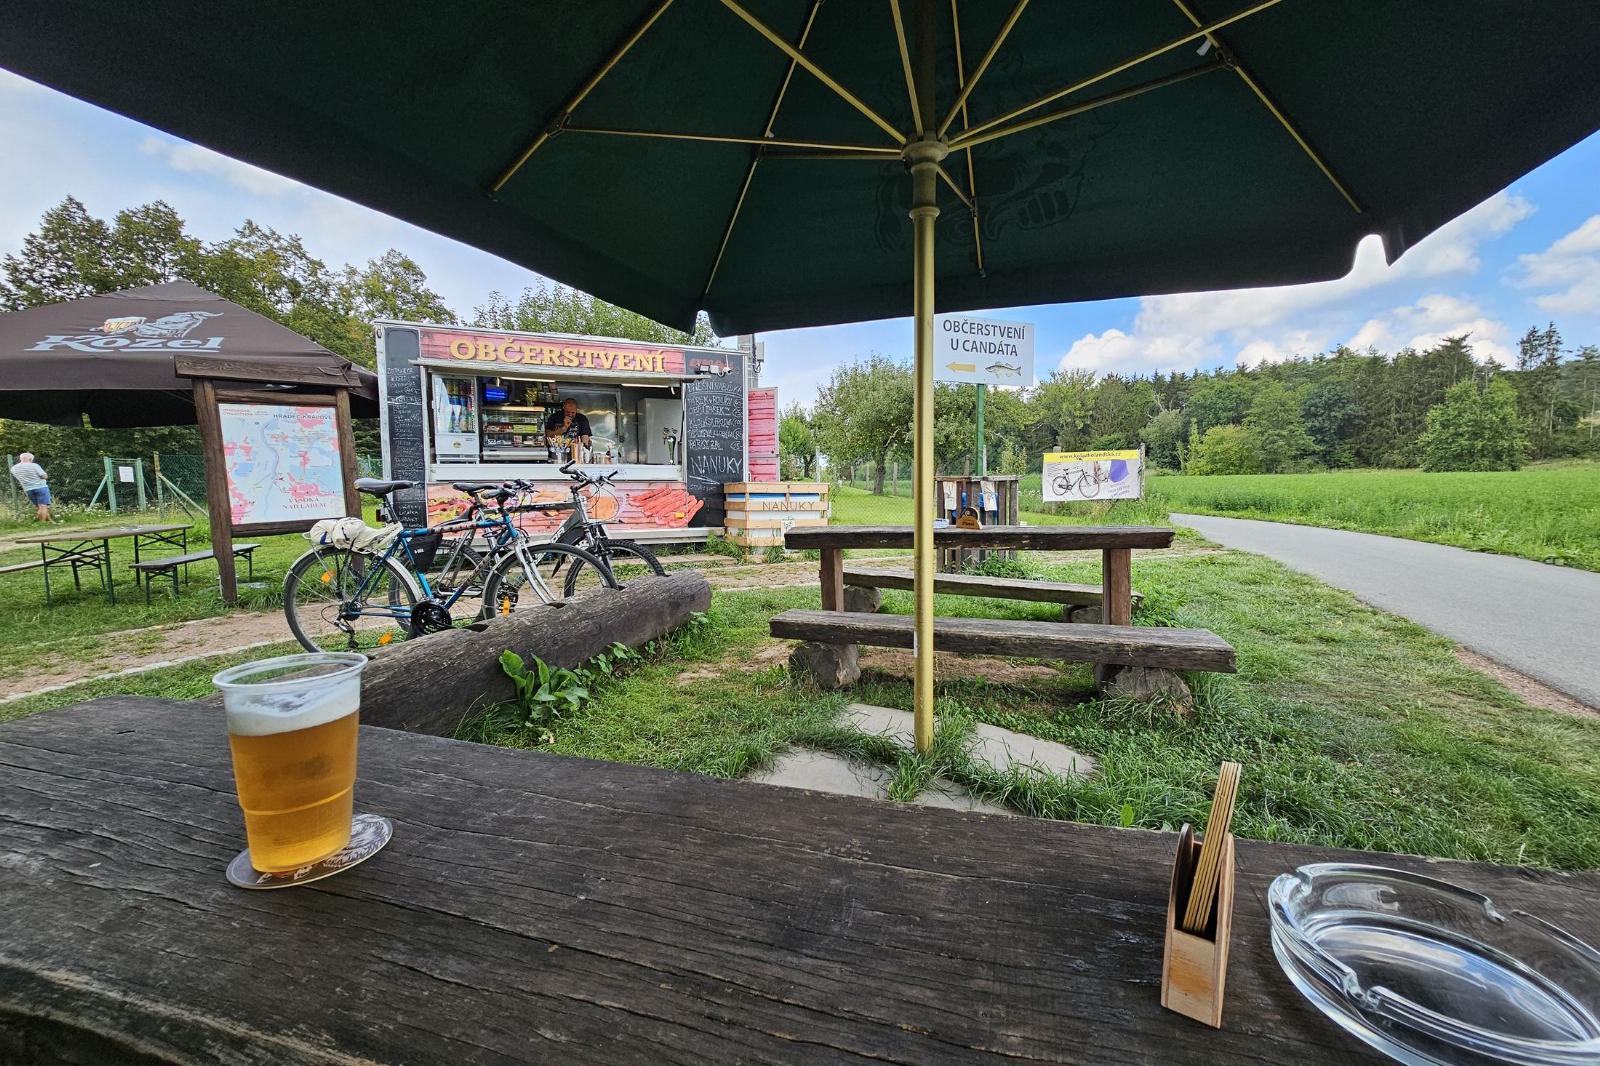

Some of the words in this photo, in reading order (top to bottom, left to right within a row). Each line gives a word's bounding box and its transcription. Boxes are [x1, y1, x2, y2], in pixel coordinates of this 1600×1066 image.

[942, 318, 1026, 340] OBČERSTVENÍ
[23, 334, 225, 353] Kozel
[950, 338, 959, 351] U
[962, 337, 1018, 357] CANDÁTA
[450, 337, 665, 372] OBČERSTVENÍ
[690, 455, 743, 475] NANUKY
[762, 501, 815, 512] NANUKY
